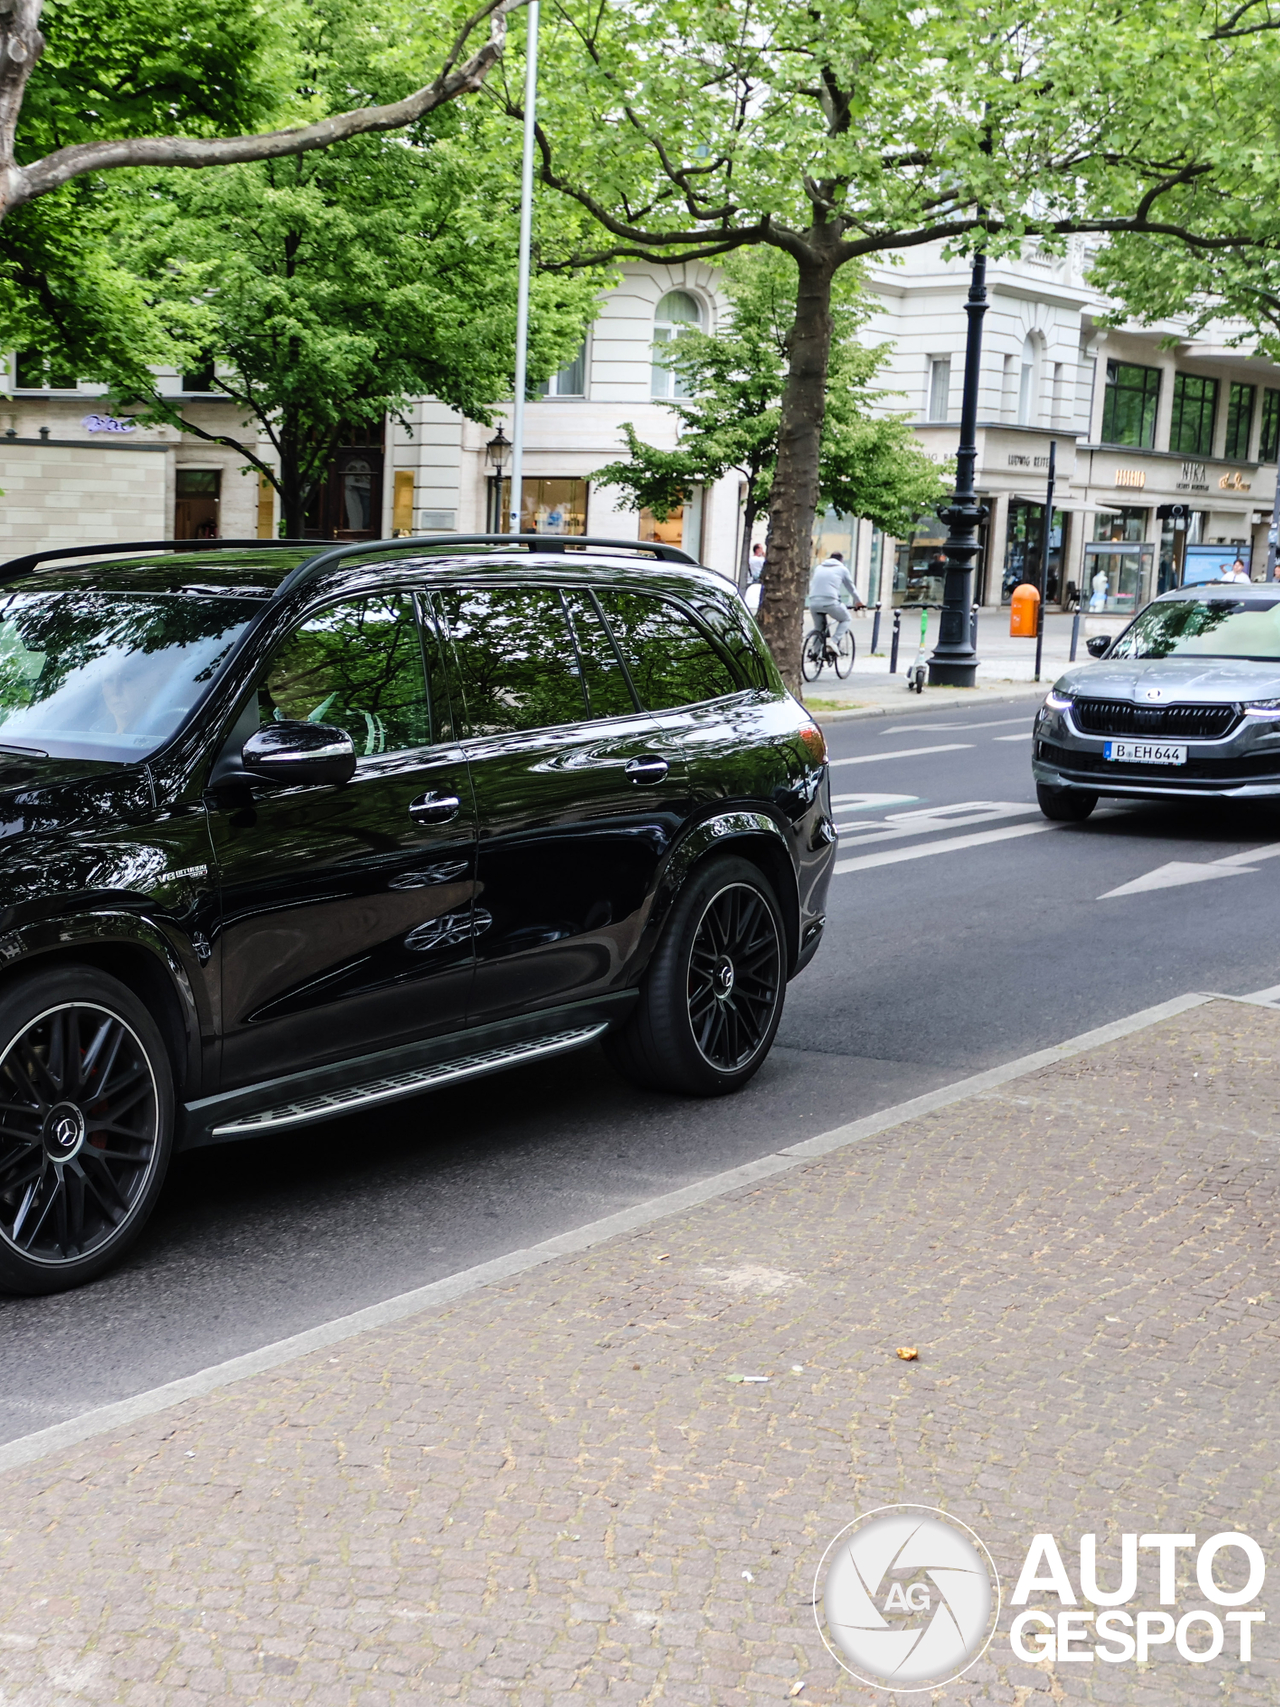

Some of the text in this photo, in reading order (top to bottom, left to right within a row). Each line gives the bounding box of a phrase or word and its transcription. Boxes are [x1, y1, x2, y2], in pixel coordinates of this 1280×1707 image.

[1007, 454, 1051, 468] LUDWIG REITE
[1181, 462, 1206, 482] NIKA
[1117, 744, 1125, 757] B
[156, 871, 176, 883] V8
